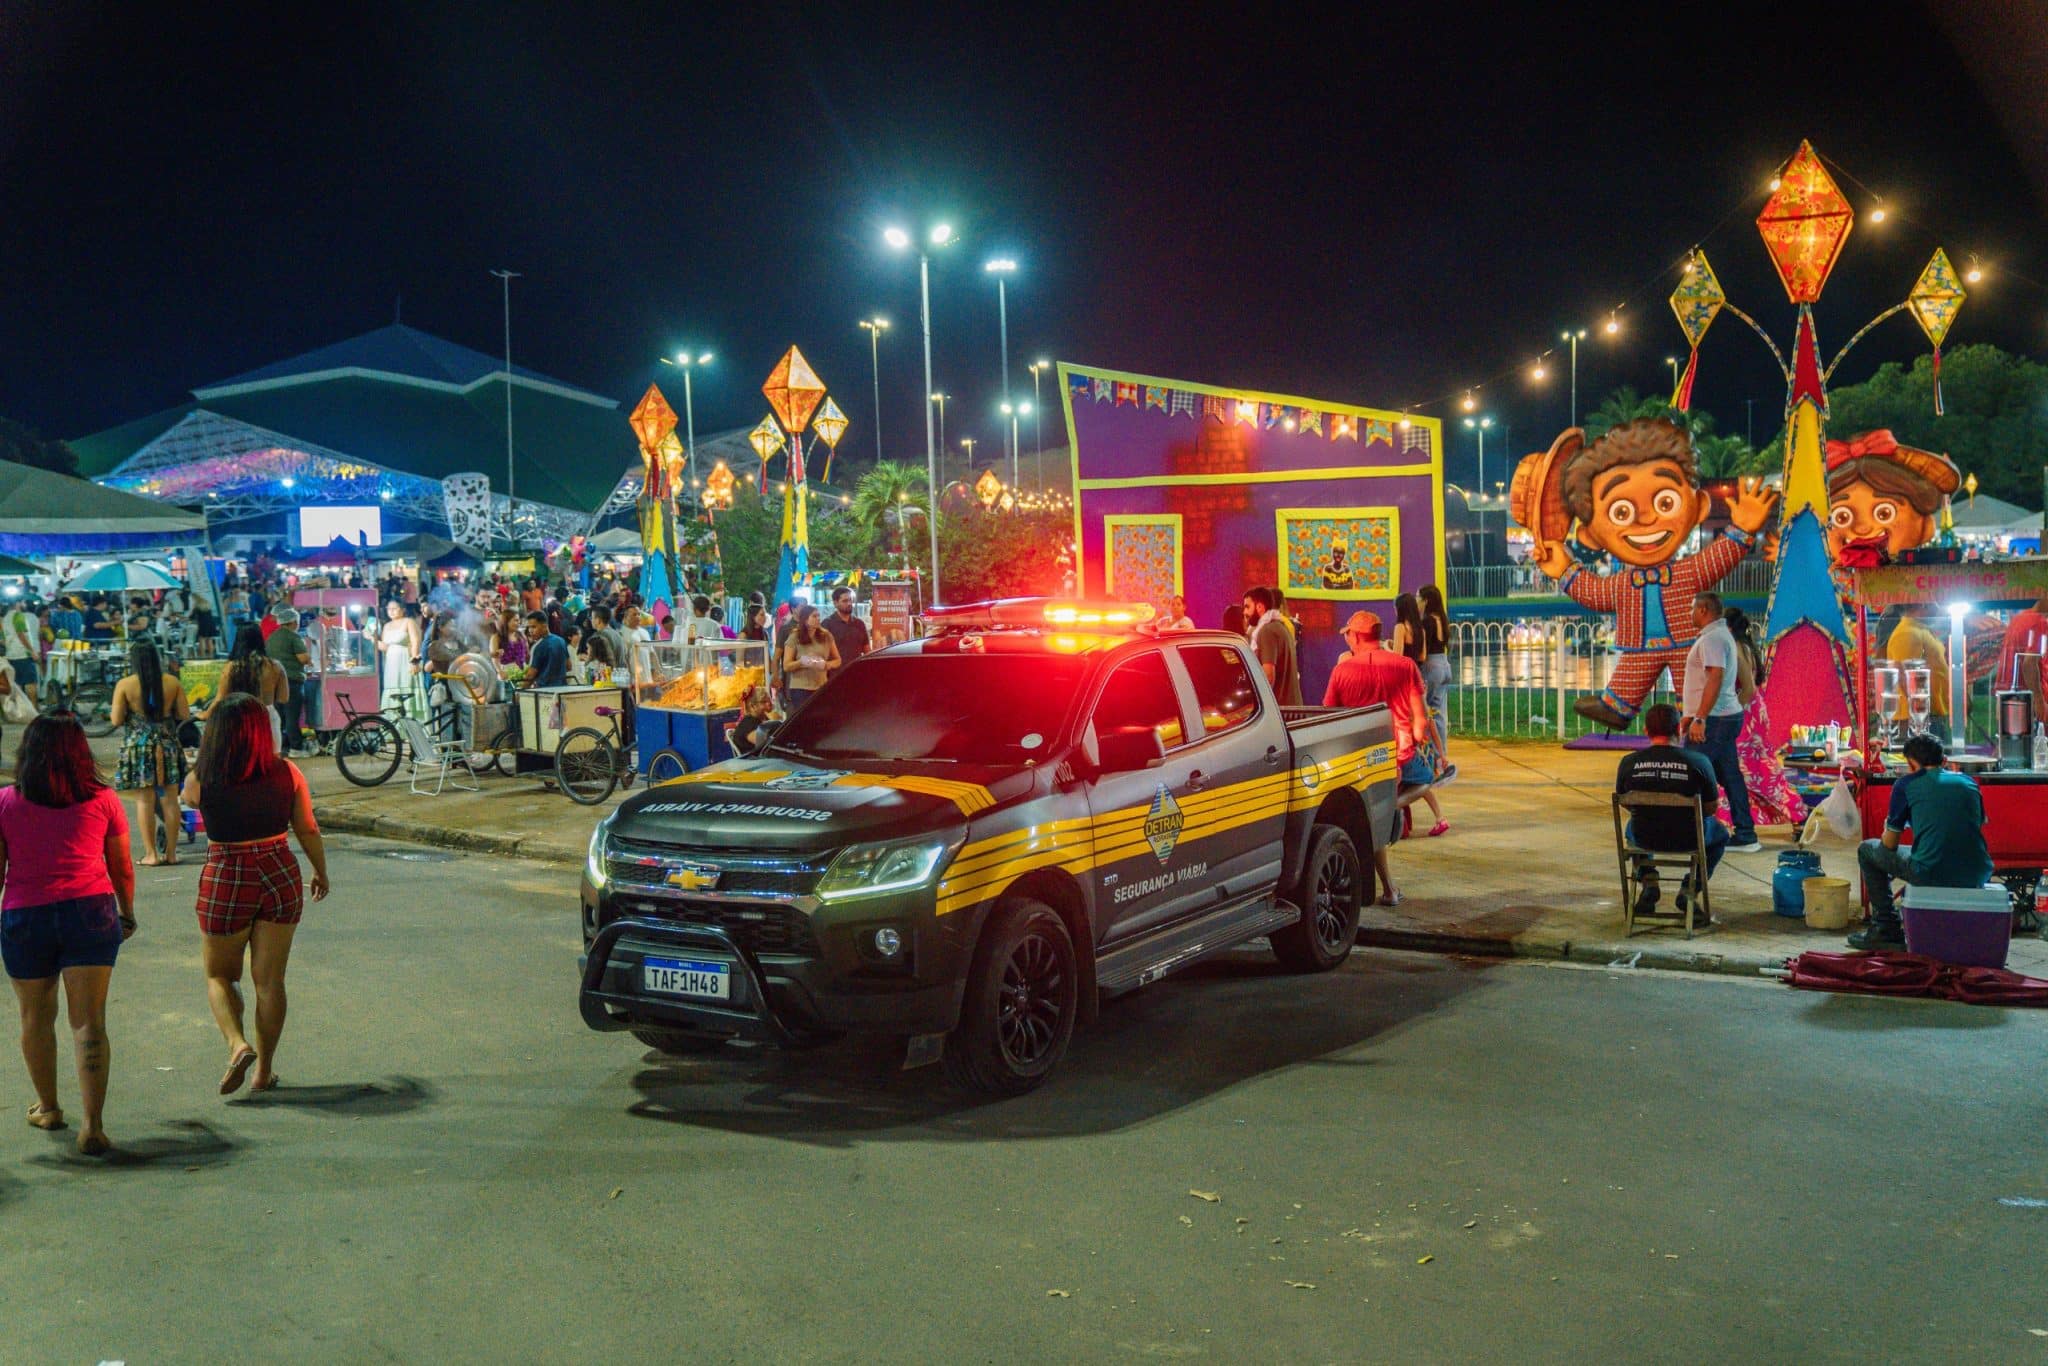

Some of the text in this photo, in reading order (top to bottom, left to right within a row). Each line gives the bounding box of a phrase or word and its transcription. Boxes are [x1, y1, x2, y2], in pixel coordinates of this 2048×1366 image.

[1915, 572, 2007, 590] CHURROS
[1633, 761, 1688, 770] AMBULANTES
[1145, 814, 1183, 836] DETRAN
[1114, 862, 1208, 903] SEGURANÇA VIÁRIA
[651, 969, 719, 994] TAF1H48
